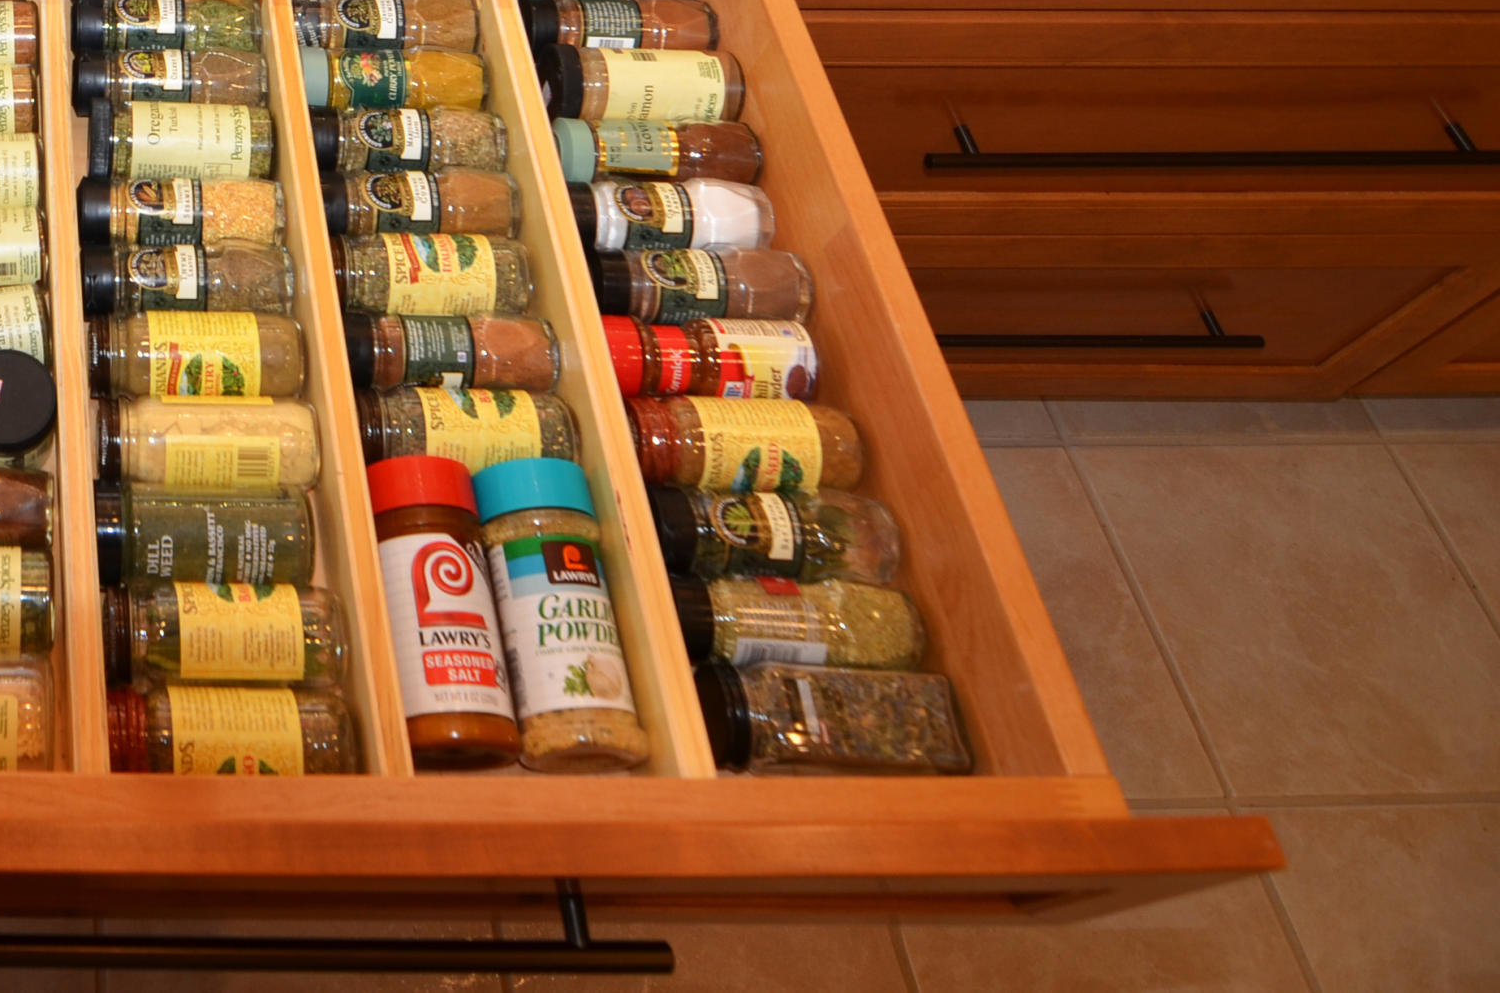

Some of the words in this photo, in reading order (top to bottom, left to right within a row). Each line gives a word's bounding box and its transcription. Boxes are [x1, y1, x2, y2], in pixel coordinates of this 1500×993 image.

[387, 71, 398, 101] CURRY
[231, 119, 246, 161] Penzeys
[418, 176, 429, 204] CUMIN
[394, 251, 409, 285] SPICE
[438, 239, 453, 273] ITALIAN
[21, 295, 37, 323] Spices
[429, 395, 445, 431] SPICE
[206, 512, 217, 557] BASSETT
[216, 525, 225, 572] FRANCISCO
[237, 535, 245, 568] NATURAL
[147, 539, 160, 576] DILL
[160, 535, 174, 577] WEED
[419, 629, 492, 650] LAWRY'S
[426, 655, 495, 670] SEASONED
[447, 669, 482, 684] SALT
